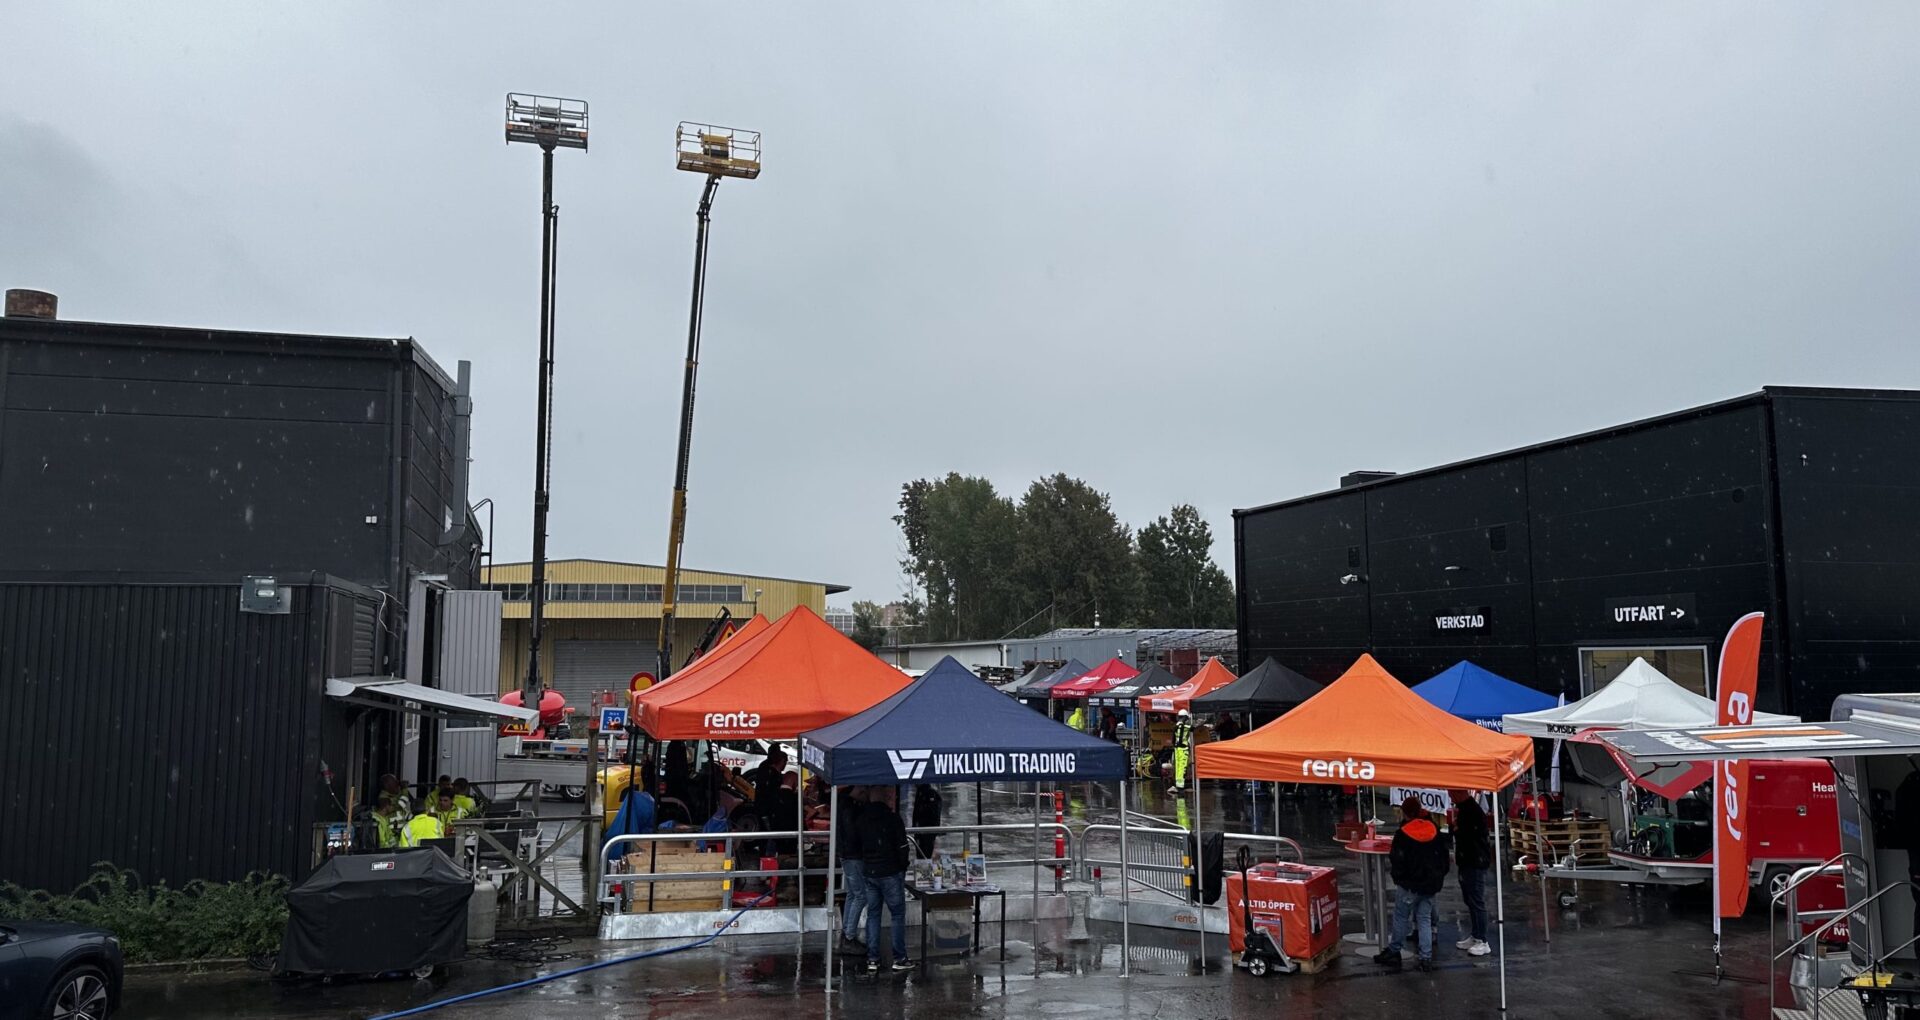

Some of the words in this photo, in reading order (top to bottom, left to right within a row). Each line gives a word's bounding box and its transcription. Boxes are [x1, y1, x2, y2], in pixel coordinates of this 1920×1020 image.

[1435, 614, 1485, 629] VERKSTAD
[1614, 605, 1665, 622] UTFART
[704, 710, 761, 728] renta
[720, 756, 746, 766] enta
[933, 753, 1005, 775] WIKLUND
[1009, 752, 1076, 774] TRADING
[1302, 757, 1376, 780] renta
[1238, 898, 1267, 909] ALTID
[1268, 898, 1296, 912] ÖPPET
[1174, 914, 1198, 924] renta
